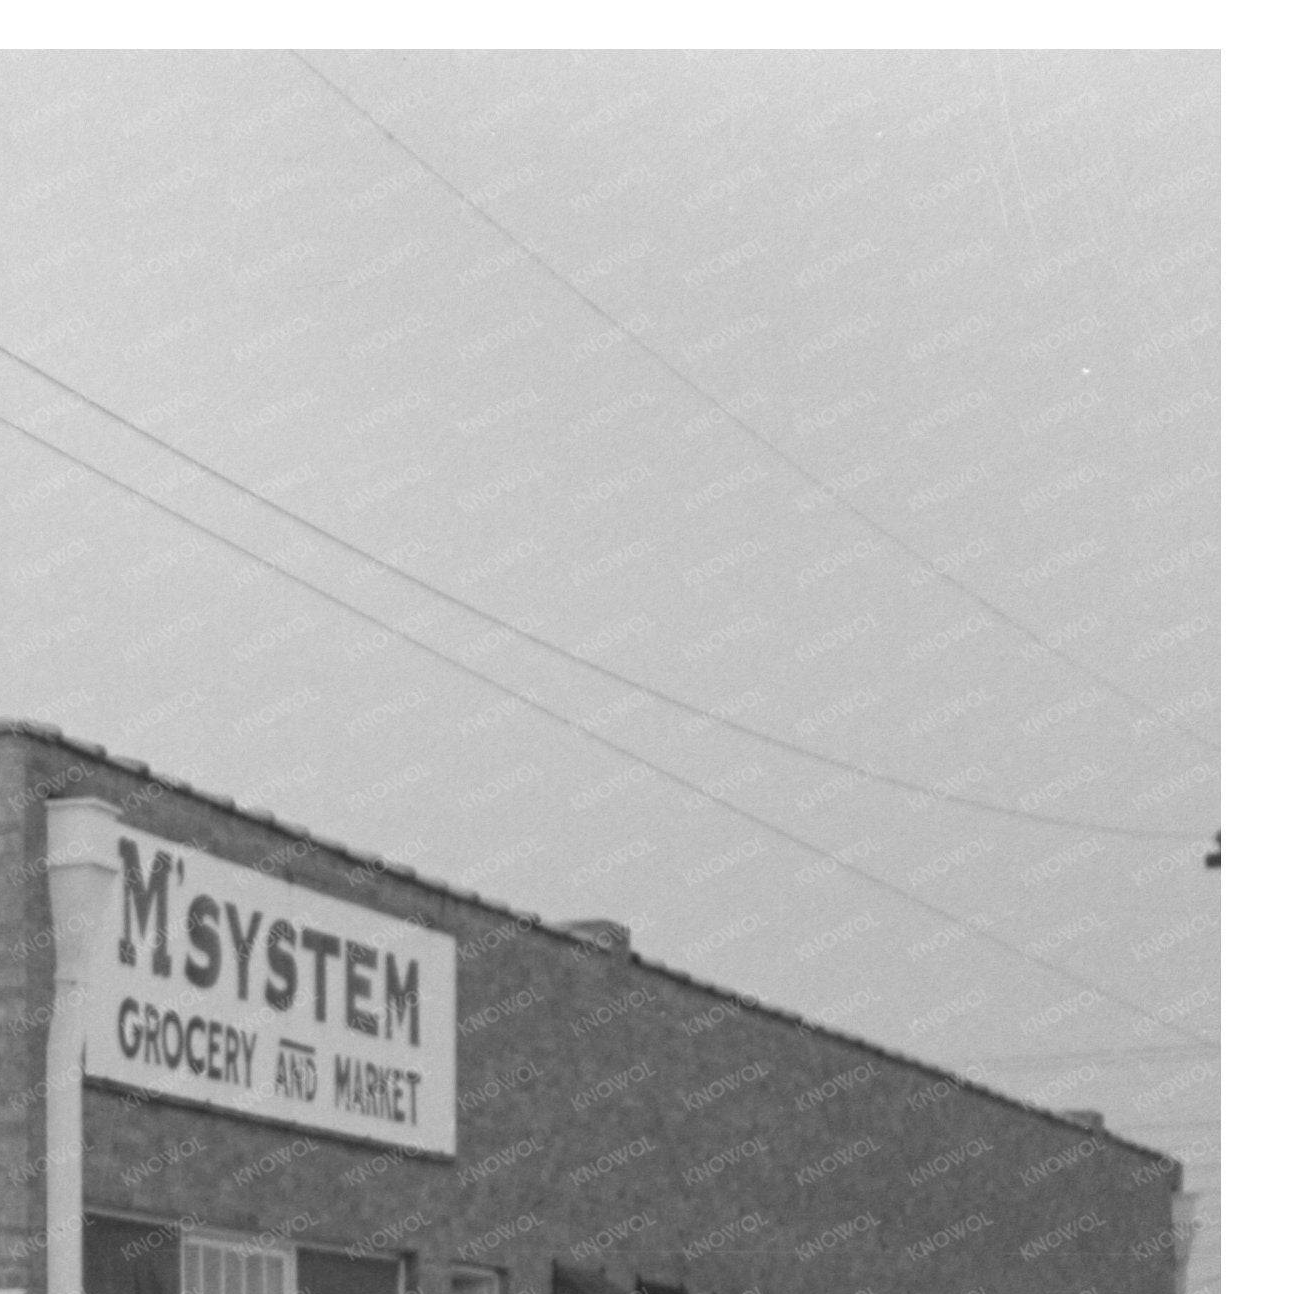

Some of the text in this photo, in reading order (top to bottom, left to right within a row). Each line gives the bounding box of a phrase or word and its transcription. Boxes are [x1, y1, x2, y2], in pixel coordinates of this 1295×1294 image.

[184, 893, 421, 1047] SYSTEM
[117, 995, 422, 1126] GROCERY AND MARKET
